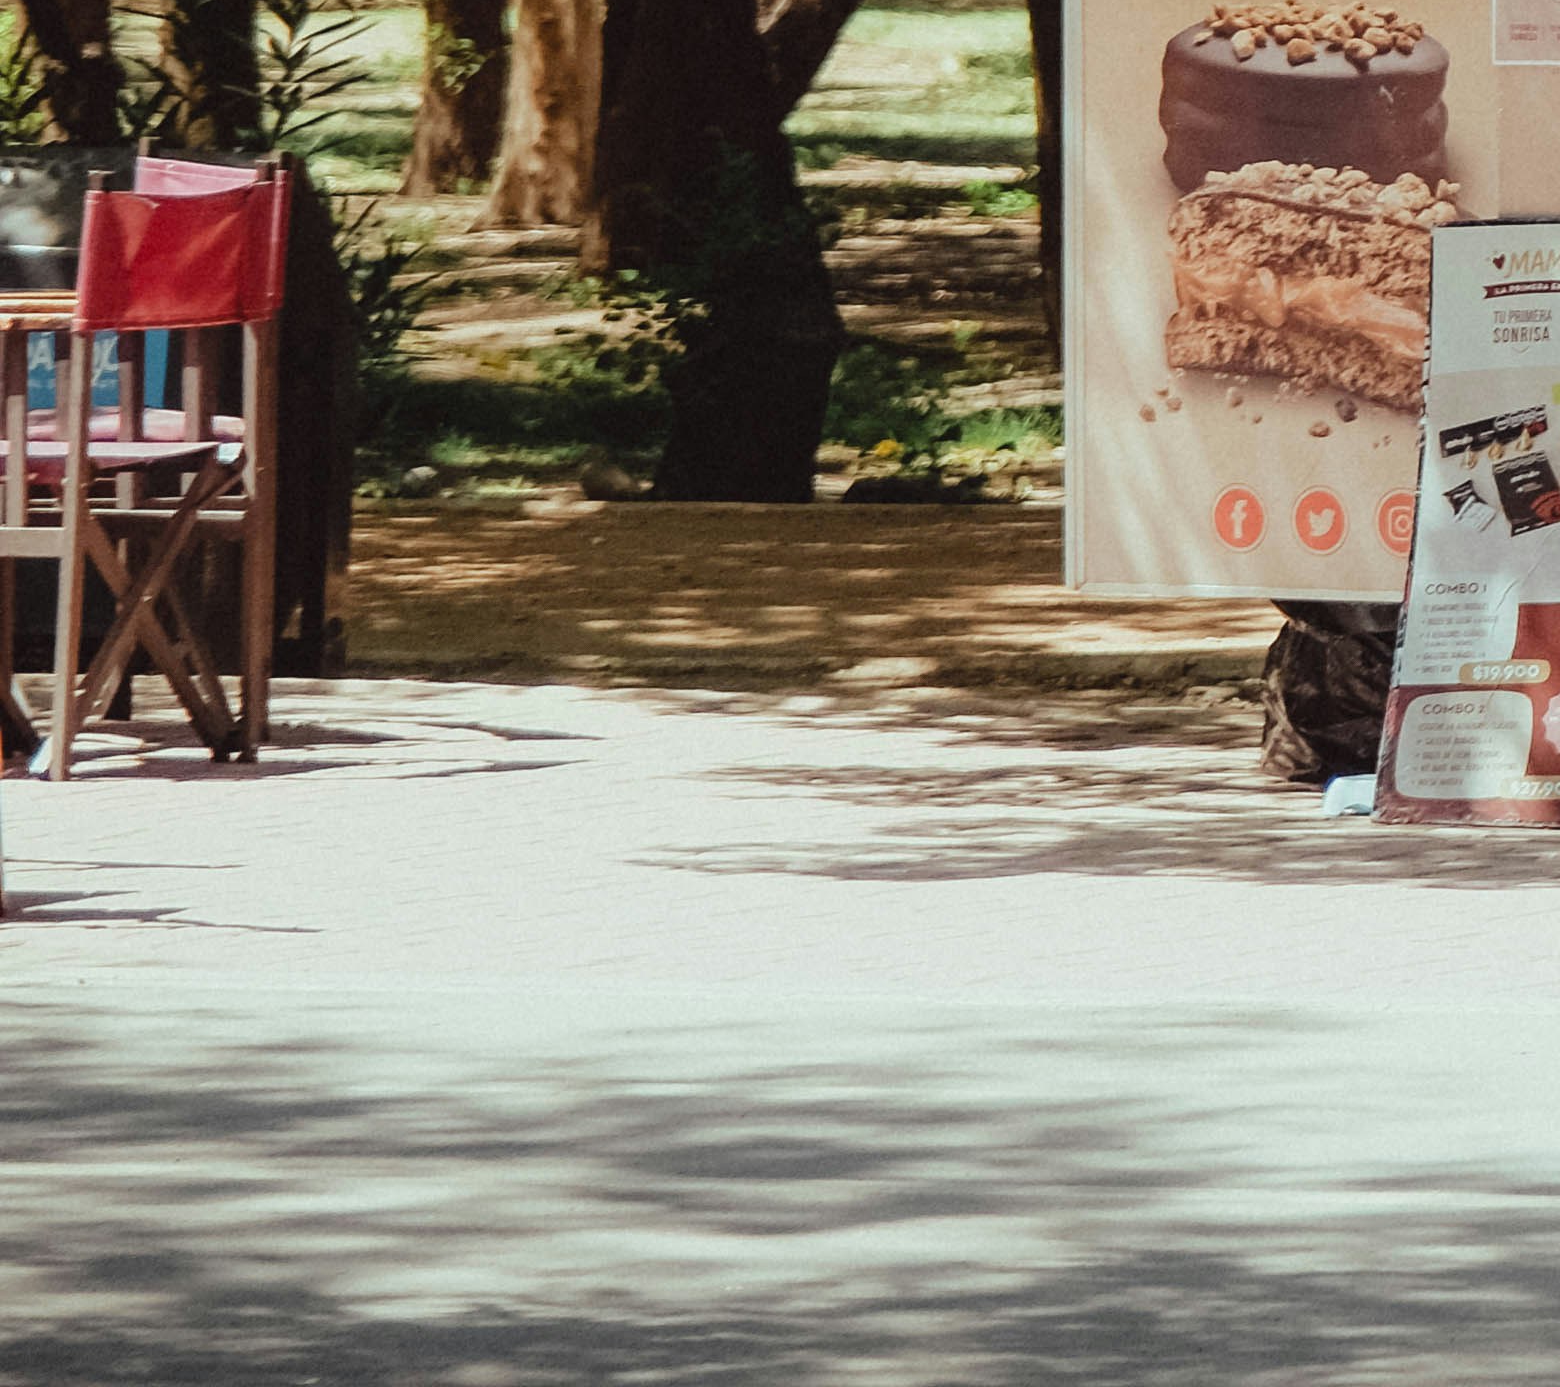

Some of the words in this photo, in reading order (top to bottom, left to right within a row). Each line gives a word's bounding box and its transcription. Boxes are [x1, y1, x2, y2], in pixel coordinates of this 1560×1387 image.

[1493, 310, 1508, 323] TU
[1492, 326, 1550, 343] SONRISA
[1424, 582, 1480, 596] COMBO
[1421, 703, 1476, 716] COMBO
